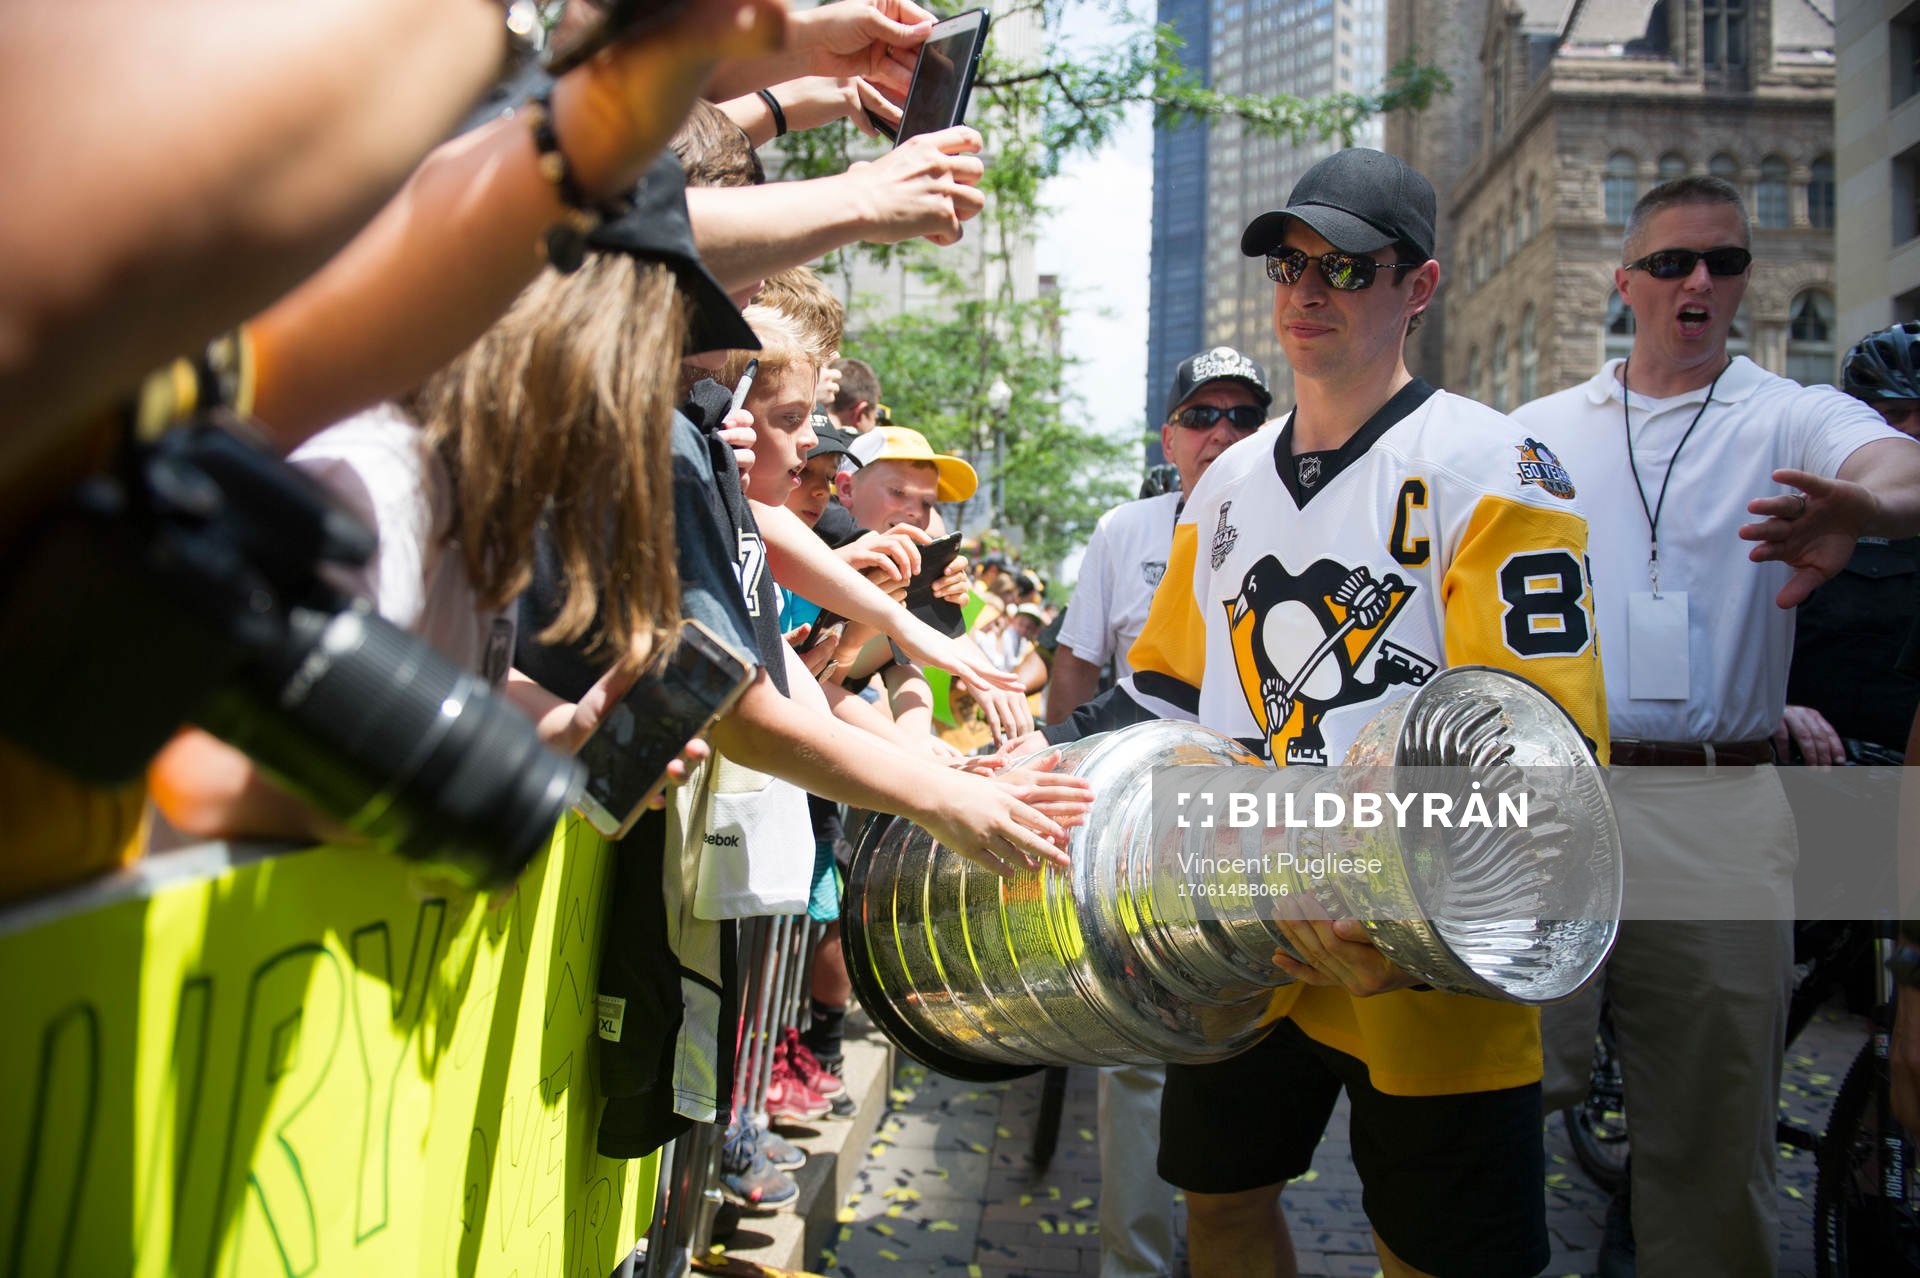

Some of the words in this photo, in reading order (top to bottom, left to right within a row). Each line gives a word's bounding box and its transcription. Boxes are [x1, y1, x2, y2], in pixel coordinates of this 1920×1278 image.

[1302, 465, 1317, 481] NHL
[1522, 463, 1541, 478] 50
[1387, 477, 1430, 568] C
[1496, 548, 1598, 660] 8
